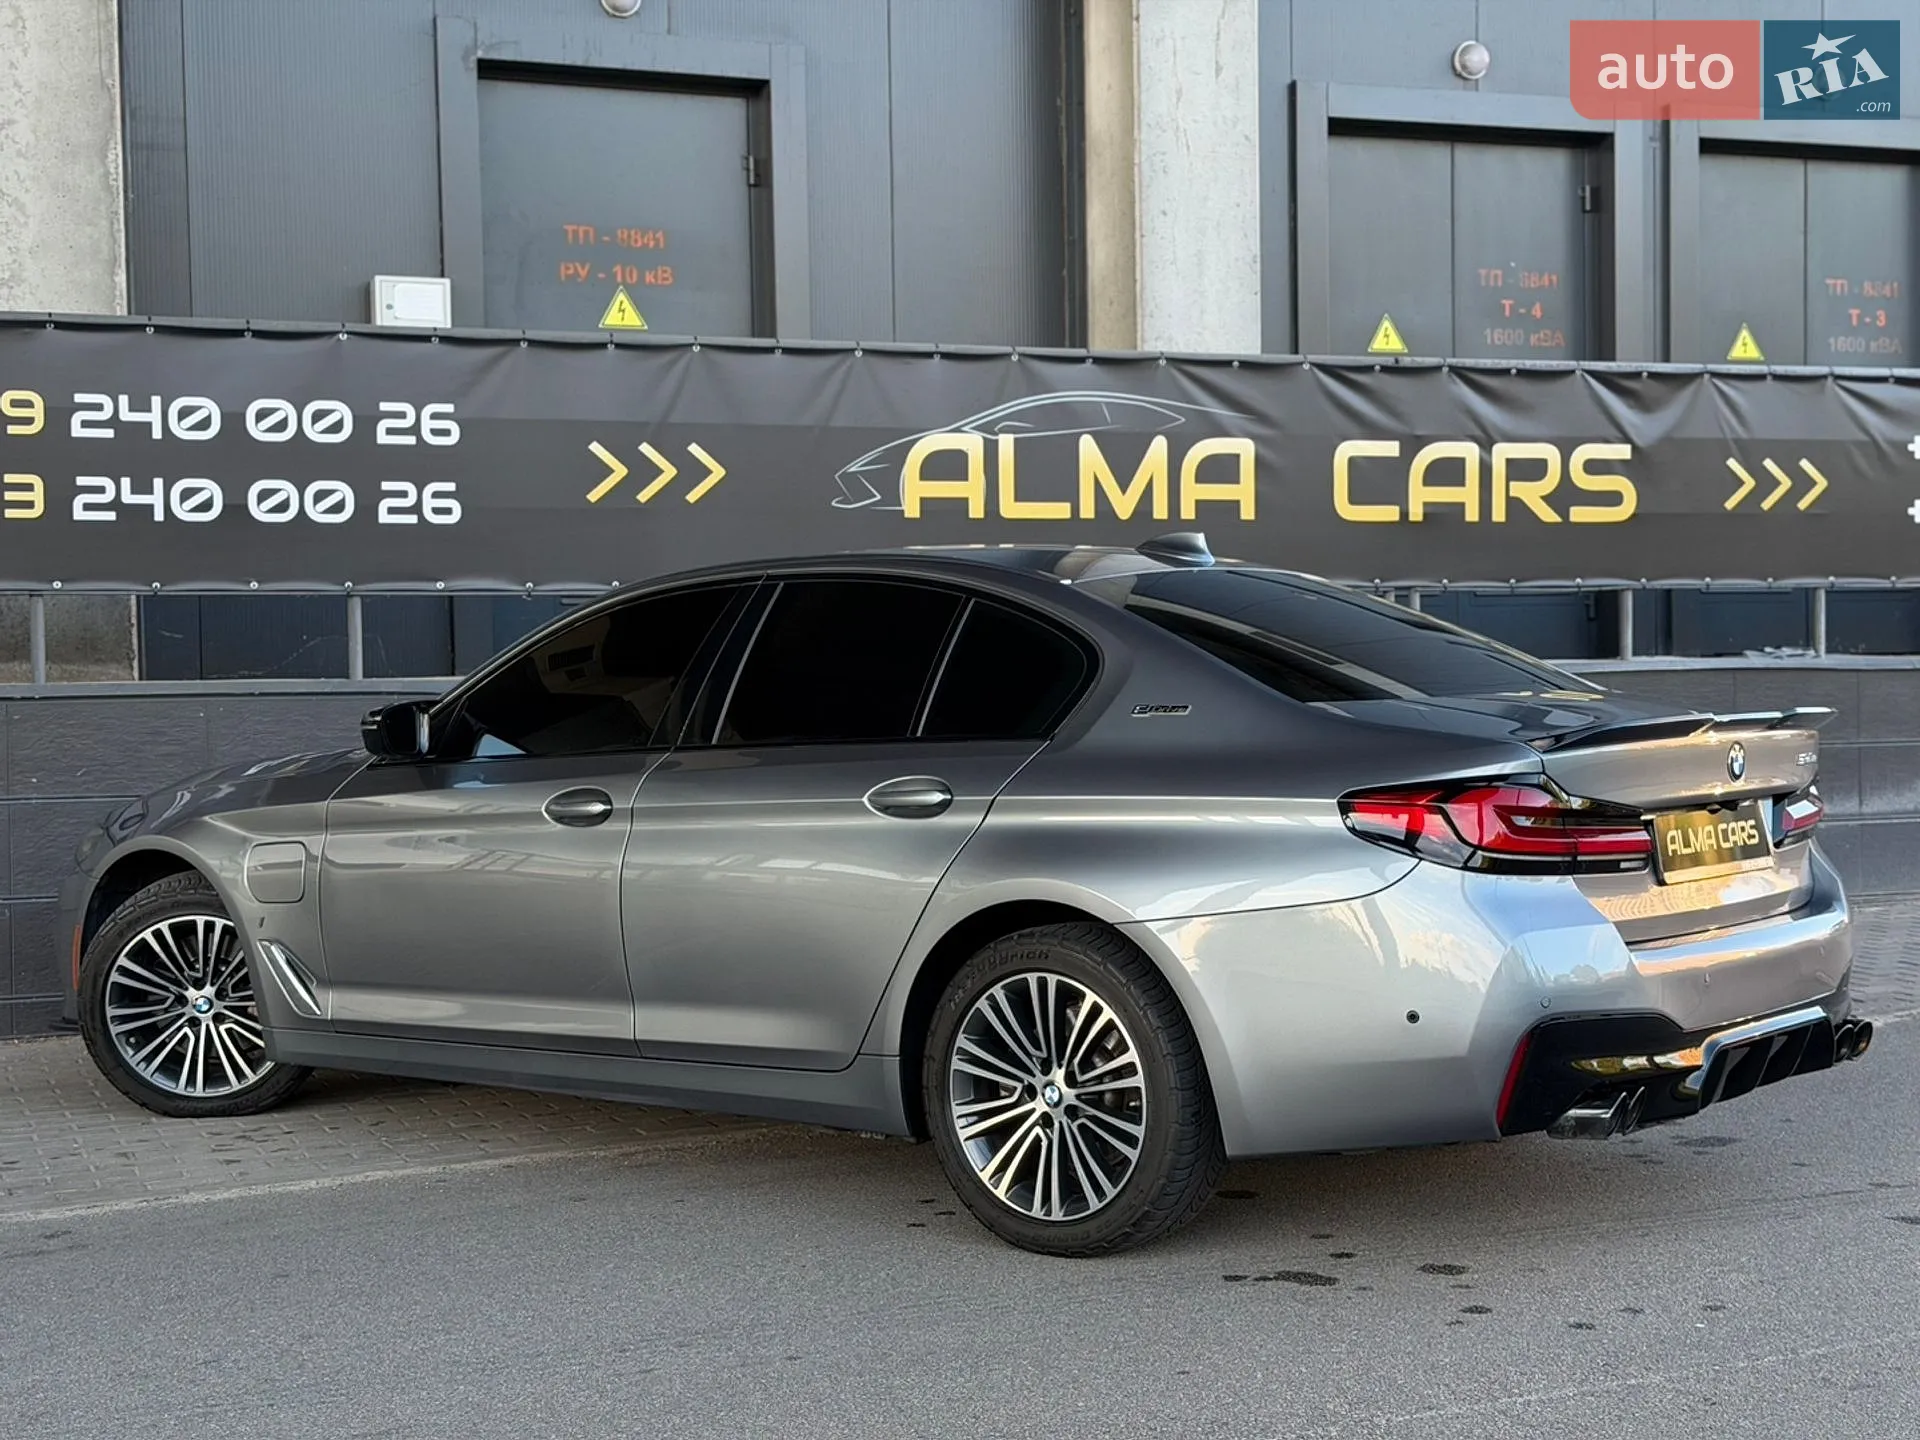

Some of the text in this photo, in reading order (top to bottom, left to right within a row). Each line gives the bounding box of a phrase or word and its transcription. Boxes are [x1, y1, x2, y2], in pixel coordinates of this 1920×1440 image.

[563, 224, 595, 245] ТП
[560, 261, 591, 282] РУ
[612, 264, 638, 284] 10
[645, 266, 674, 285] кВ
[1478, 268, 1503, 287] ТП
[1825, 278, 1848, 296] ТП
[1501, 299, 1515, 318] Т
[1531, 301, 1543, 320] 4
[1848, 308, 1861, 327] Т
[1876, 309, 1887, 327] 3
[1483, 328, 1565, 347] 1600 кВА
[1828, 336, 1866, 353] 1600
[71, 393, 221, 441] 240
[245, 398, 353, 443] 00
[376, 401, 461, 446] 26
[904, 432, 1638, 523] ALMA CARS
[3, 473, 462, 525] 3 240 00 26
[1666, 819, 1759, 857] ALMA CARS
